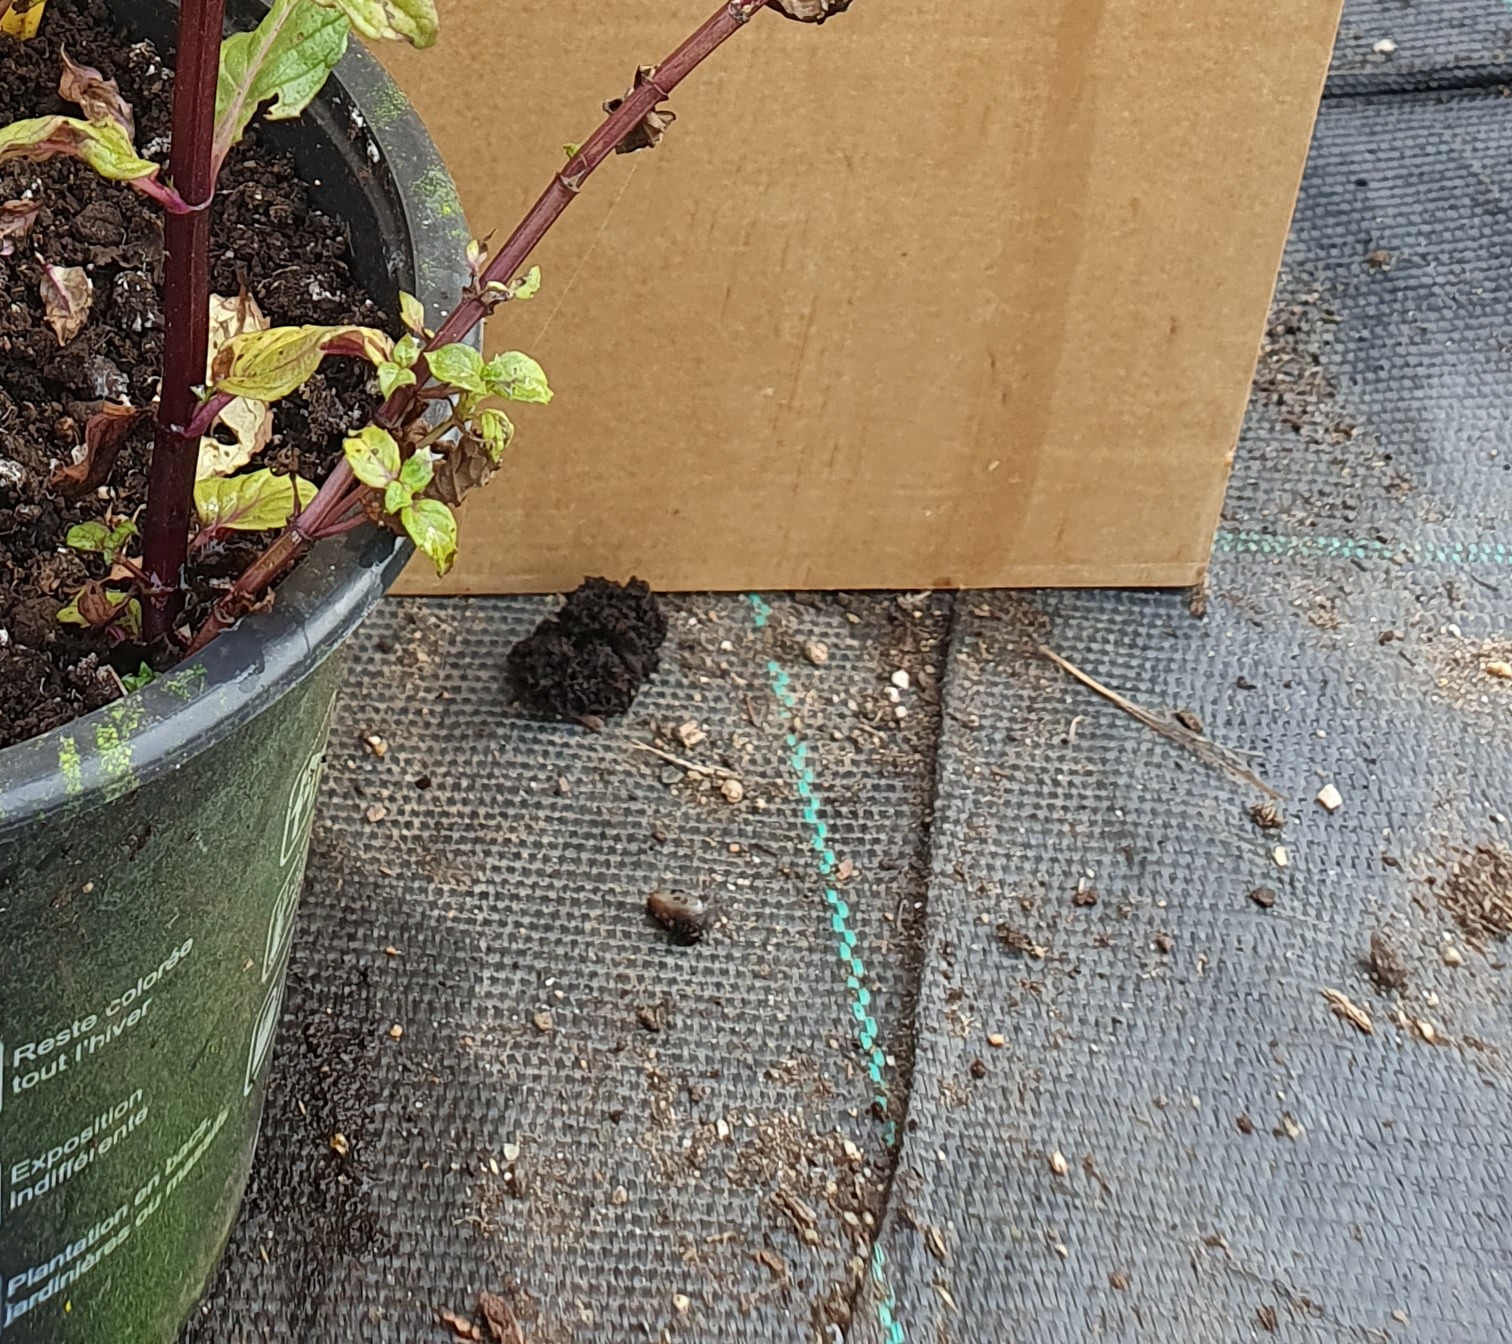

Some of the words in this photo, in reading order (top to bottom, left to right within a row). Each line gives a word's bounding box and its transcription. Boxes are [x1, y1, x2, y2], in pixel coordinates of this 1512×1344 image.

[12, 1053, 68, 1094] tout
[75, 997, 154, 1062] l'hiver
[13, 1014, 98, 1068] Reste
[105, 937, 194, 1017] colorée
[10, 1088, 143, 1185] Exposition
[4, 1224, 131, 1328] jardinières
[135, 1192, 162, 1227] ou
[7, 1204, 129, 1298] Plantation
[134, 1173, 161, 1206] en
